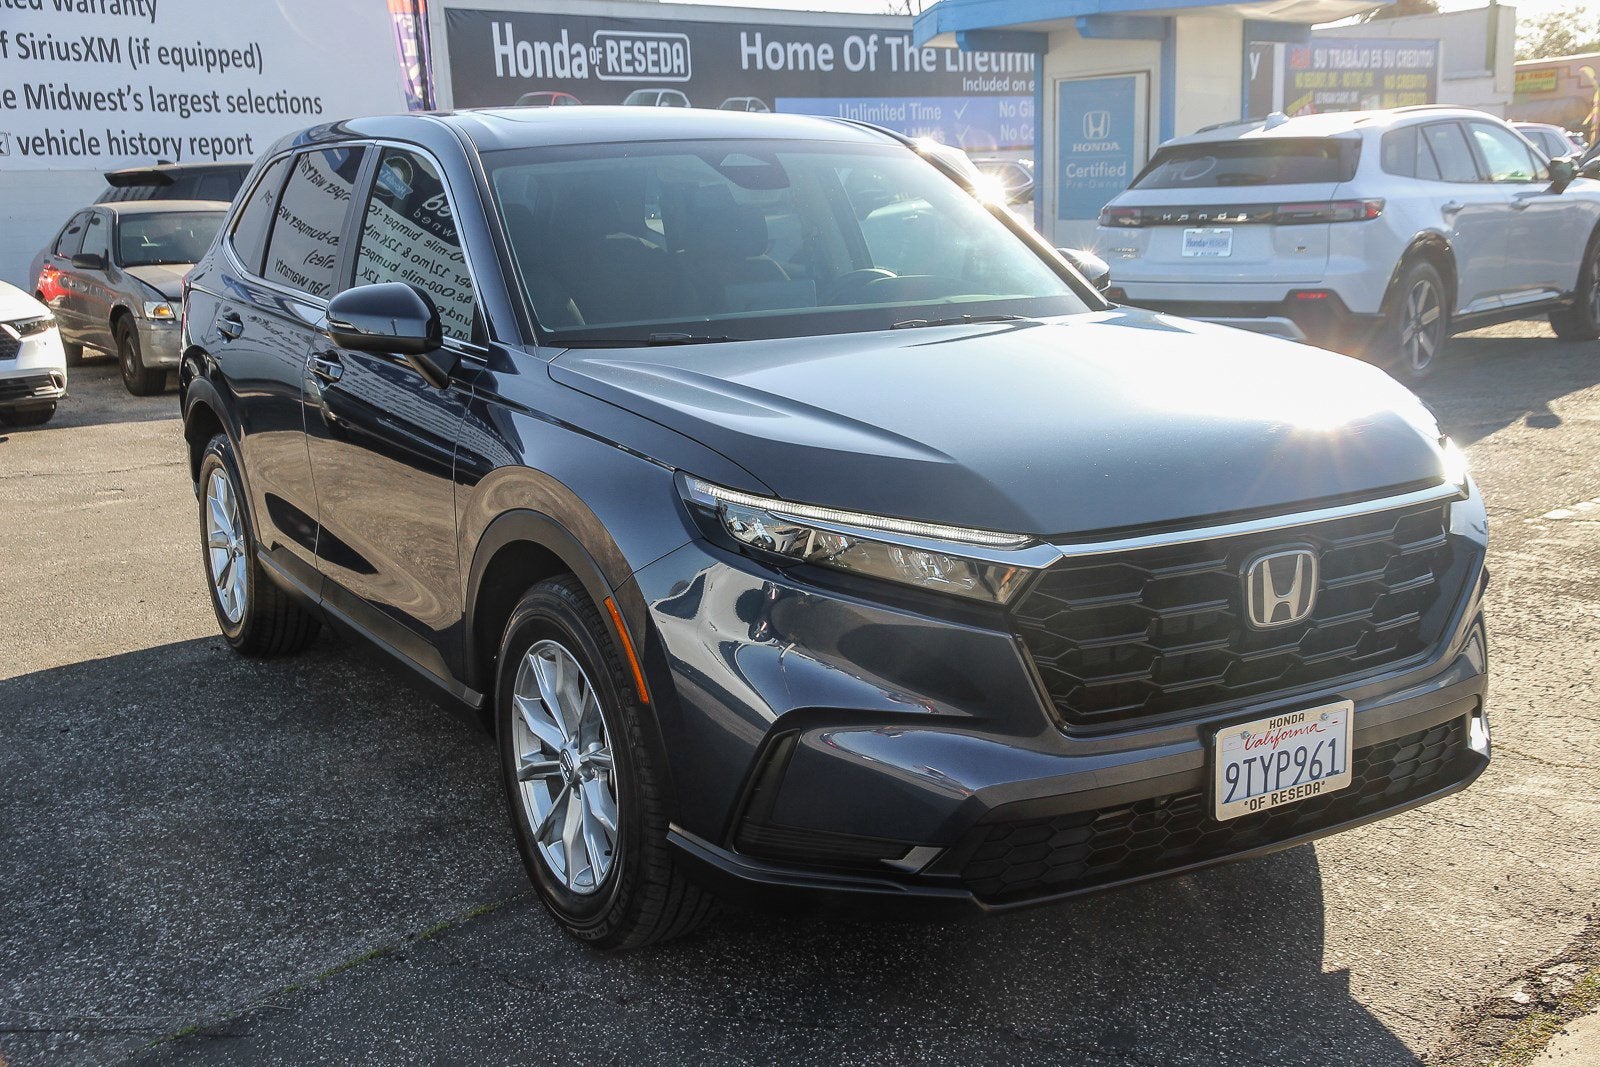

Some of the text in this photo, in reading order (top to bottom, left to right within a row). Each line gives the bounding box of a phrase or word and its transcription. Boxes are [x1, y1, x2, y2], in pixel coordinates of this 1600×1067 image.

[16, 32, 121, 63] SiriusXM
[128, 36, 151, 70] (if
[157, 42, 264, 75] equipped)
[492, 22, 588, 79] Honda
[606, 40, 685, 74] RESEDA
[740, 32, 834, 71] Home
[843, 34, 878, 72] Of
[885, 37, 936, 72] The
[963, 77, 1009, 92] Included
[1012, 80, 1026, 92] on
[0, 83, 323, 118] e Midwest's largest selections
[838, 103, 941, 122] Unlimited Time
[999, 102, 1016, 118] No
[17, 129, 101, 156] vehicle
[106, 130, 182, 161] history
[189, 134, 254, 161] report
[1072, 142, 1120, 152] HONDA
[1066, 161, 1126, 178] Certified
[1269, 713, 1305, 729] HONDA
[1245, 722, 1326, 750] California
[1222, 738, 1339, 804] 9TYP961
[1250, 781, 1320, 811] OF RESEDA
